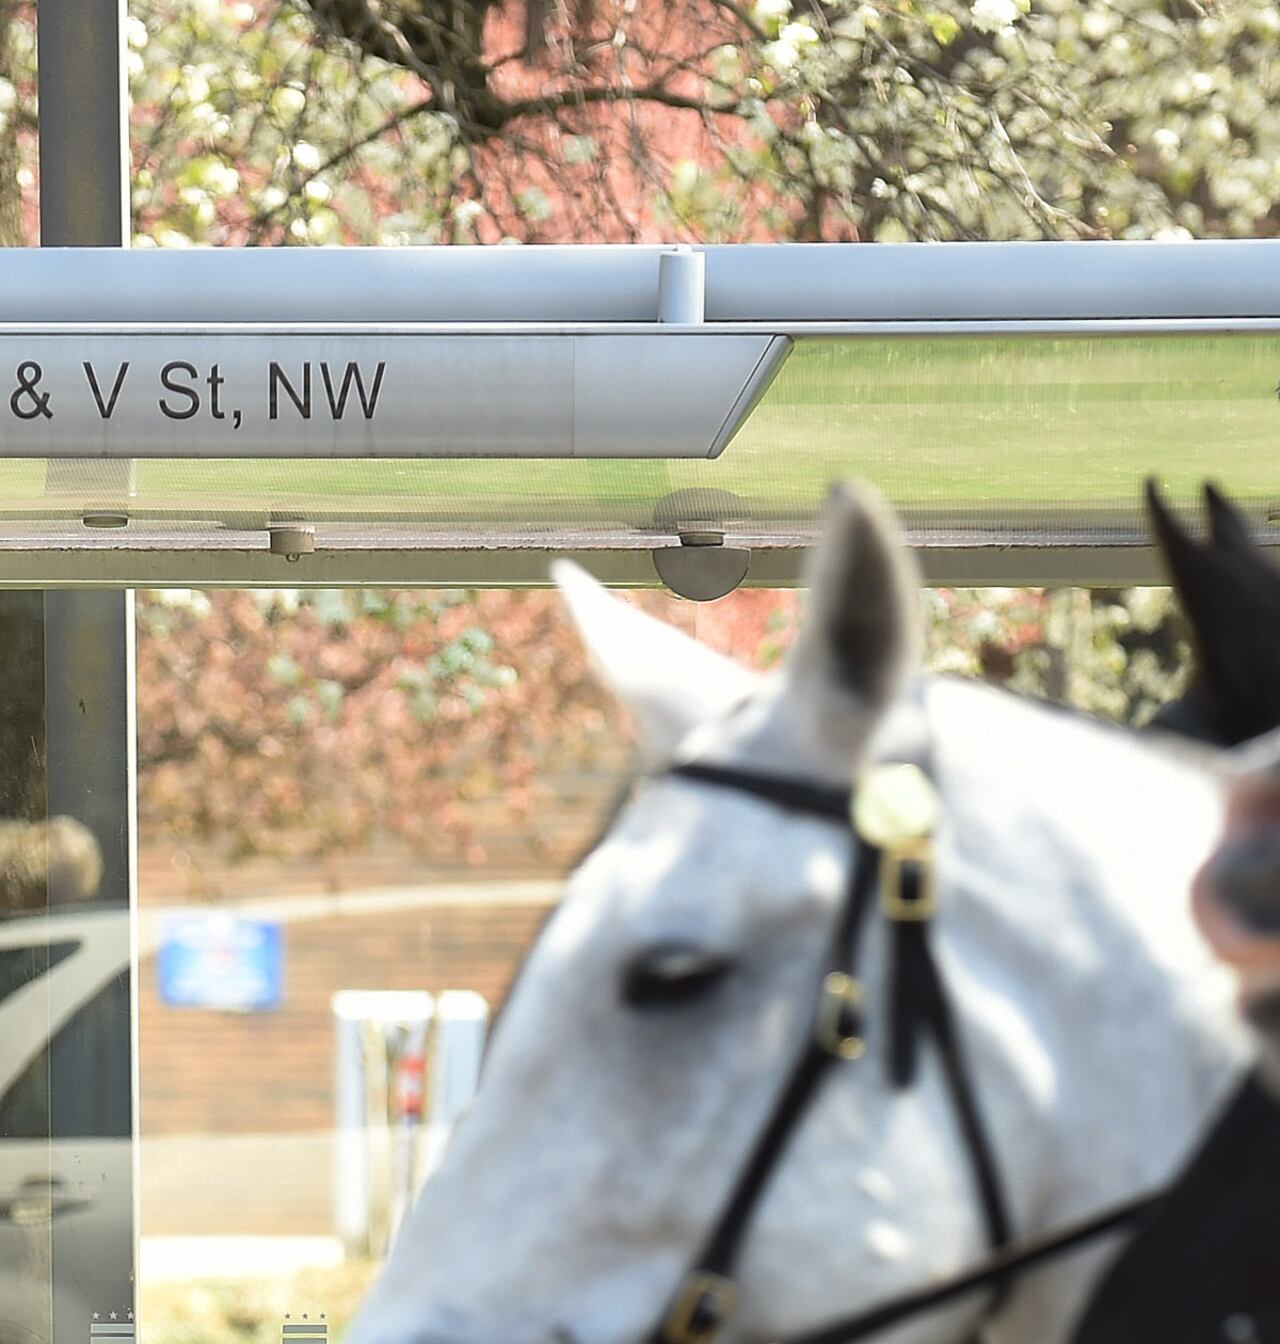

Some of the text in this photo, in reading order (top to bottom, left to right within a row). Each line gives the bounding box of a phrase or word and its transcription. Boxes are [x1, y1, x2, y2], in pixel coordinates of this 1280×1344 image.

[10, 361, 54, 420] &
[83, 361, 130, 419] V
[158, 361, 242, 430] St,
[269, 362, 387, 421] NW
